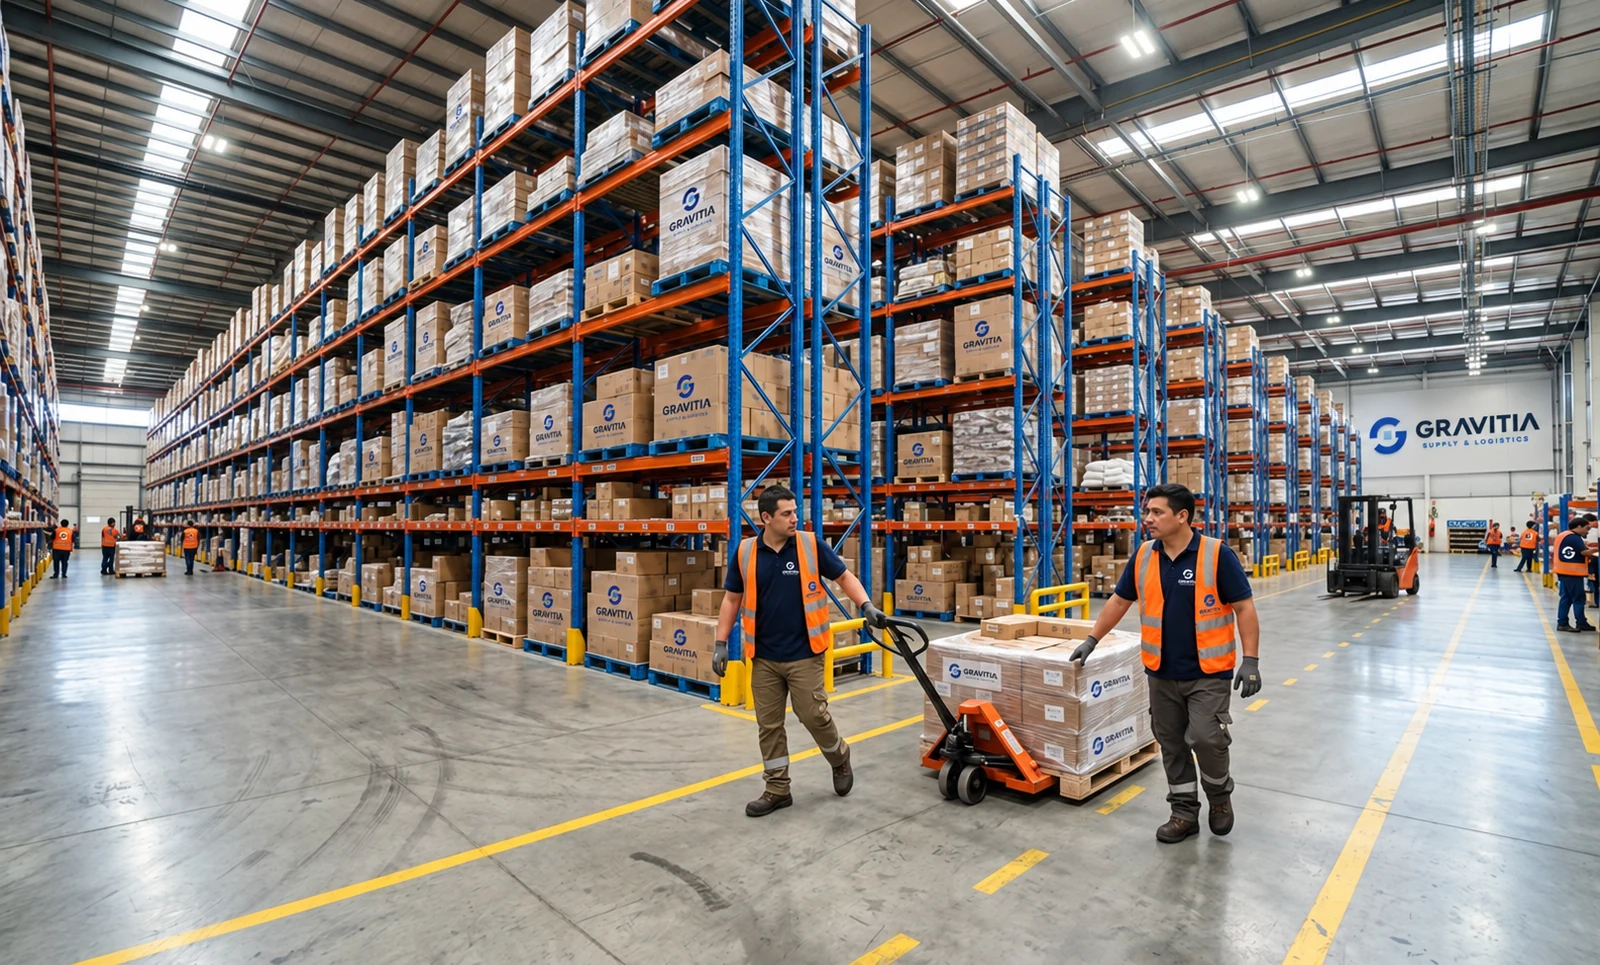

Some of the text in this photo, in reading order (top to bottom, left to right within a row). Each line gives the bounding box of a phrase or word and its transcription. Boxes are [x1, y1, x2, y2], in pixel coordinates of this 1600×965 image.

[669, 205, 715, 232] GRAVITIA
[963, 336, 1002, 349] GRAVITIA
[662, 398, 711, 415] GRAVITIA
[593, 421, 626, 434] GRAVITIA
[1415, 412, 1540, 439] GRAVITIA
[1422, 440, 1458, 449] SUPPLY
[1474, 436, 1529, 445] LOGISTICS
[596, 606, 633, 620] GRAVITIA
[663, 645, 698, 659] GRAVITIA
[963, 668, 998, 680] GRAVITIA
